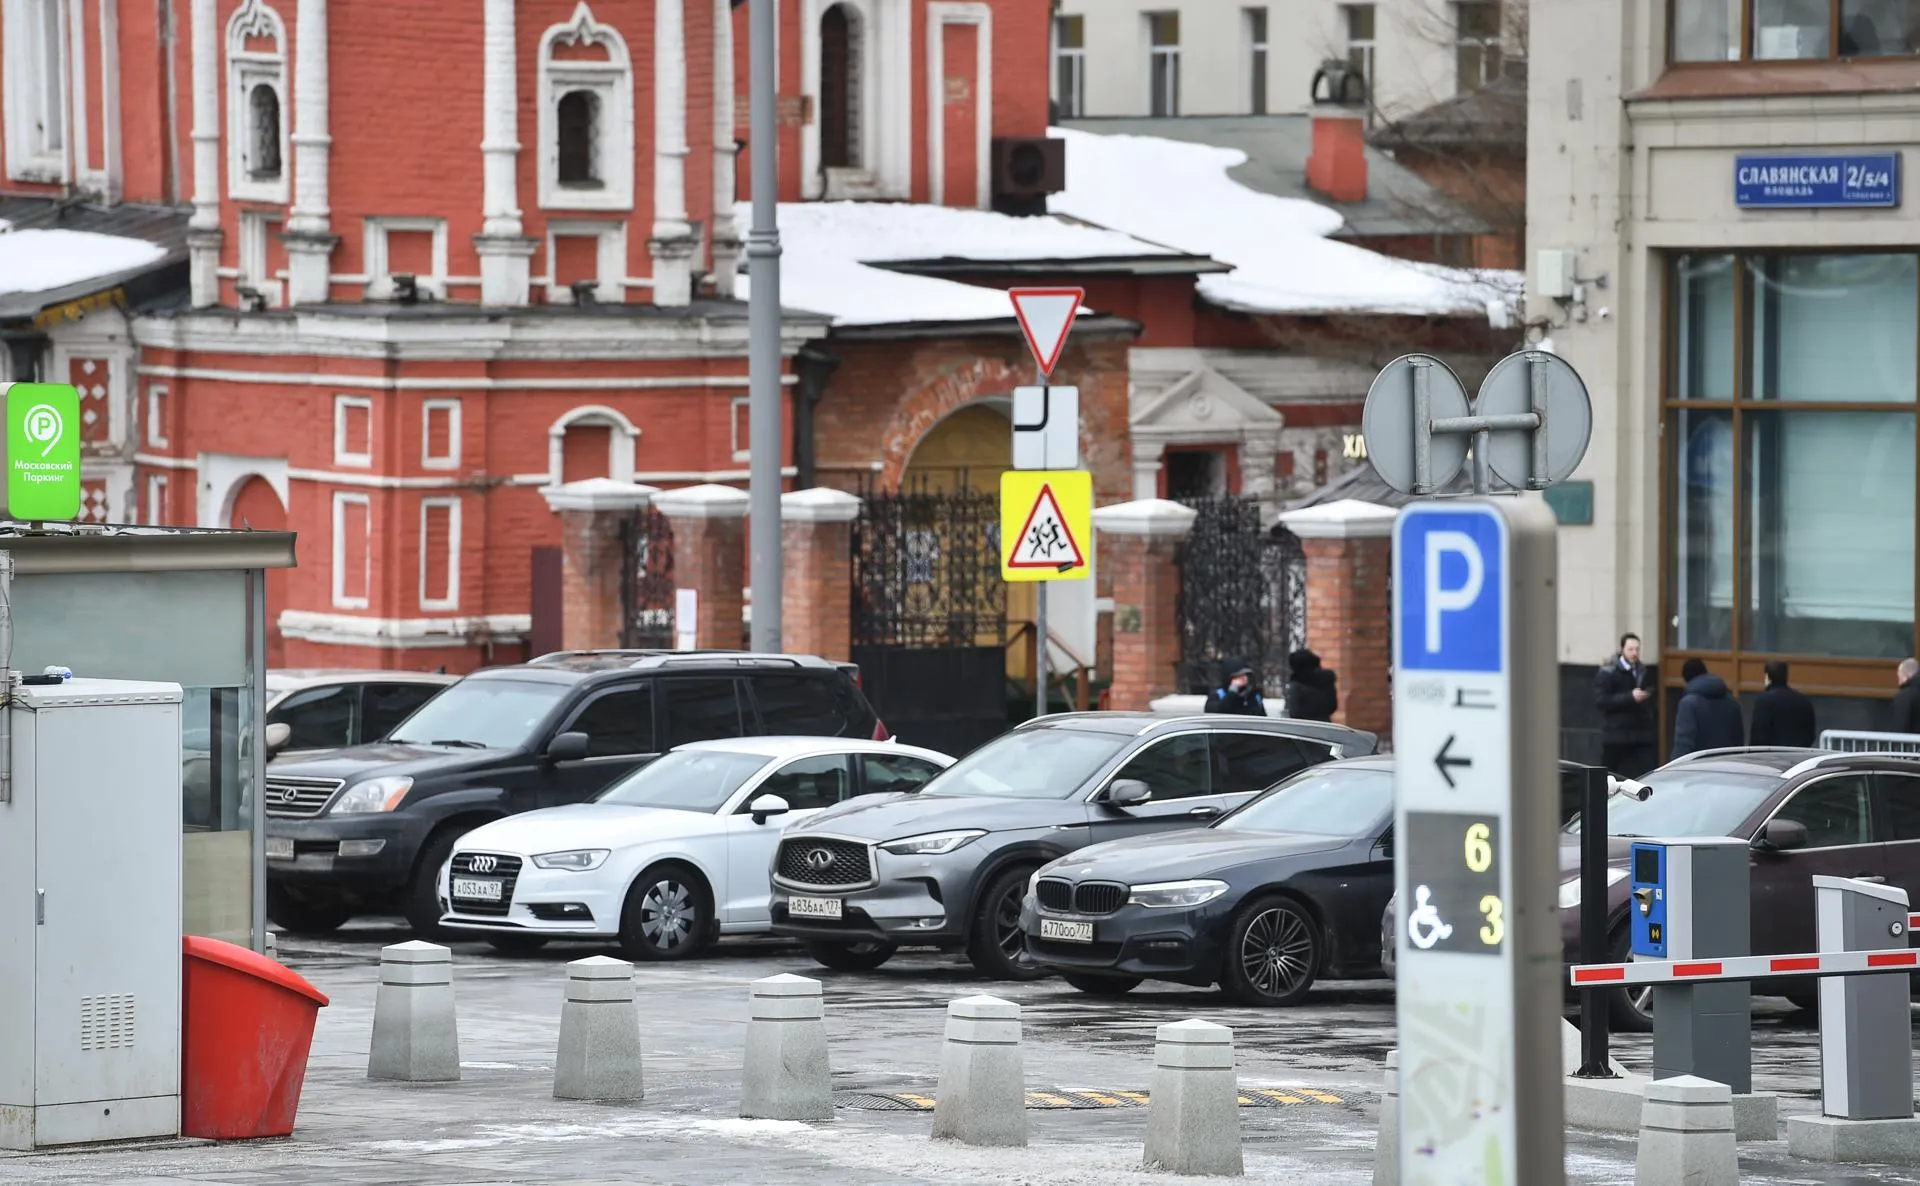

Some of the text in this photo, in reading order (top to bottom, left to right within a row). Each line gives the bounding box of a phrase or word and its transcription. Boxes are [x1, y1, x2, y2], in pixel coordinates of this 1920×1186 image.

[1738, 164, 1889, 189] СЛАВЯНСКАЯ 2/5/4
[14, 460, 73, 471] Московский
[23, 472, 65, 484] Паркинг
[1425, 530, 1485, 654] P
[1464, 823, 1493, 872] 6
[1479, 895, 1505, 946] 3
